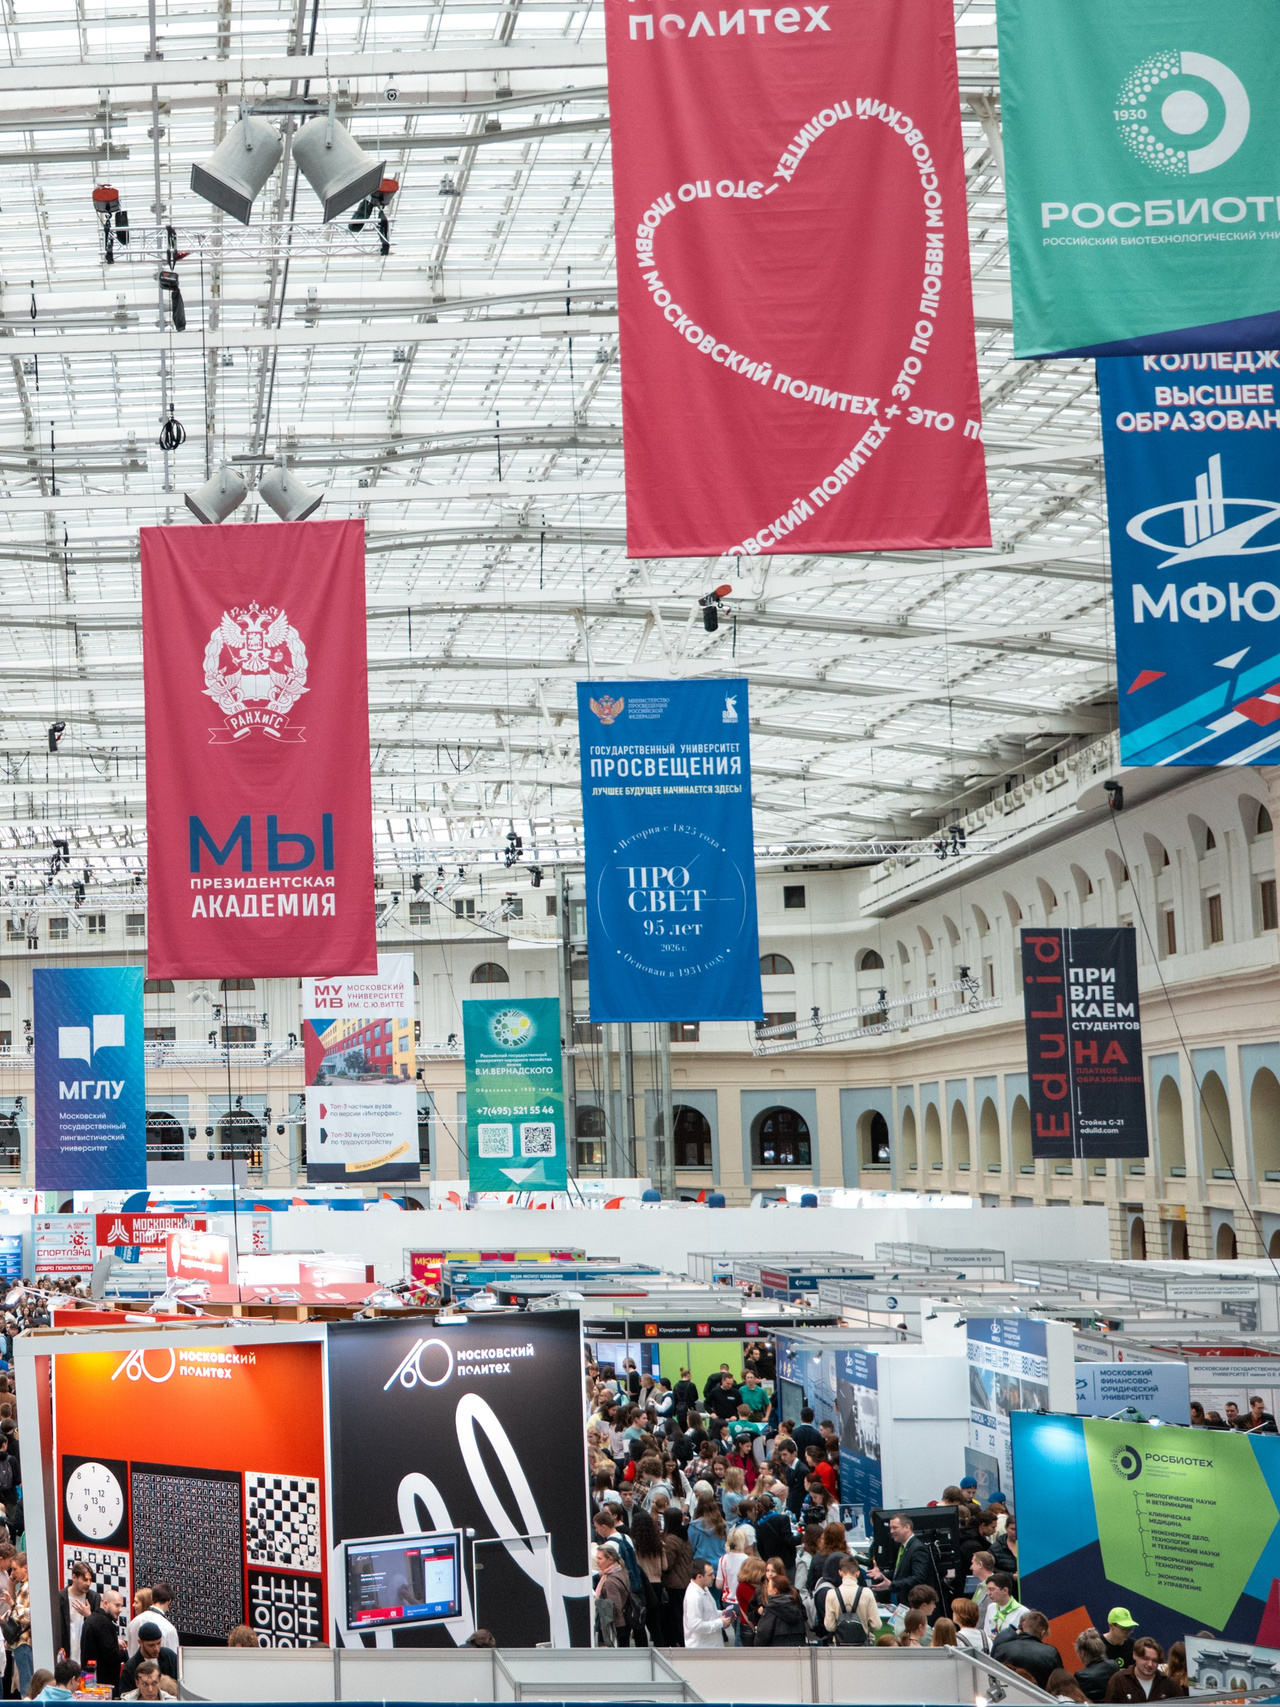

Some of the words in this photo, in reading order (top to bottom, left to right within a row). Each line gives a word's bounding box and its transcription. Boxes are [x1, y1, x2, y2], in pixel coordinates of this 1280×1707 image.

[1113, 109, 1147, 121] 1930
[774, 100, 853, 183] ПОЛИТЕХ
[856, 98, 944, 228] МОСКОВСКИЙ
[678, 180, 711, 202] ПО
[716, 179, 763, 199] ЭТО
[636, 192, 676, 268] ЛЮБВИ
[1043, 234, 1118, 246] РОССИЙСКИЙ
[1120, 230, 1256, 245] БИОТЕХНОЛОГИЧЕСКИЙ
[919, 233, 944, 319] ЛЮБВИ
[642, 270, 772, 385] МОСКОВСКИЙ
[909, 321, 933, 354] ПО
[891, 359, 922, 401] ЭТО
[773, 373, 879, 416] ПОЛИТЕХ
[1155, 384, 1275, 407] ВЫСШЕЕ
[906, 406, 954, 431] ЭТО
[808, 418, 891, 508] ПОЛИТЕХ
[229, 712, 284, 729] РАНХиГС
[590, 743, 675, 756] ГОСУДАРСТВЕННЫЙ
[680, 743, 740, 754] УНИВЕРСИТЕТ
[590, 756, 741, 778] ПРОСВЕЩЕНИЯ
[592, 786, 623, 796] ЛУЧШЕЕ
[625, 786, 662, 796] БУДУЩЕЕ
[663, 785, 713, 795] НАЧИНАЕТСЯ
[714, 784, 742, 794] ЗДЕСЬ!
[189, 812, 334, 873] МЫ
[619, 826, 660, 849] История
[673, 824, 697, 835] 1825
[699, 832, 720, 848] года
[190, 875, 335, 889] ПРЕЗИДЕНТСКАЯ
[627, 866, 690, 889] ПРО
[191, 893, 336, 918] АКАДЕМИЯ
[628, 889, 707, 912] СВЕТ
[643, 919, 665, 936] 95
[669, 923, 703, 935] лет
[660, 944, 680, 952] 2026
[624, 953, 666, 977] Основан
[679, 964, 702, 977] 1931
[1069, 968, 1116, 983] ПРИ
[315, 985, 343, 996] МУ
[347, 982, 404, 991] МОСКОВСКИЙ
[1070, 985, 1115, 1000] ВЛЕ
[315, 997, 344, 1009] ИВ
[347, 992, 404, 1000] УНИВЕРСИТЕТ
[1071, 1002, 1135, 1018] КАЕМ
[1071, 1021, 1140, 1031] СТУДЕНТОВ
[1074, 1040, 1129, 1065] НА
[475, 1066, 554, 1076] В.И.ВЕРНАДСКОГО
[1076, 1075, 1143, 1083] ОБРАЗОВАНИЕ
[59, 1080, 125, 1100] МГЛУ
[59, 1112, 107, 1120] Московский
[476, 1106, 512, 1117] +7(495)
[513, 1106, 529, 1116] 521
[530, 1106, 541, 1115] 55
[542, 1105, 554, 1115] 46
[60, 1122, 127, 1131] государственный
[1108, 1118, 1124, 1126] G-21
[60, 1133, 125, 1141] лингвистический
[60, 1144, 108, 1152] университет
[36, 1248, 92, 1257] СПОРТЛЭНД
[179, 1351, 256, 1365] московский
[457, 1343, 534, 1361] московский
[179, 1365, 232, 1380] политех
[457, 1361, 511, 1377] политех
[1100, 1369, 1153, 1377] МОСКОВСКИЙ
[1101, 1385, 1158, 1394] ЮРИДИЧЕСКИЙ
[1101, 1393, 1154, 1401] УНИВЕРСИТЕТ
[1145, 1453, 1214, 1468] РОСБИОТЕХ
[1145, 1492, 1195, 1503] БИОЛОГИЧЕСКИЕ
[1148, 1511, 1192, 1521] КЛИНИЧЕСКАЯ
[1154, 1554, 1215, 1569] ИНФОРМАЦИОННЫЕ
[1163, 1581, 1202, 1592] УПРАВЛЕНИЕ
